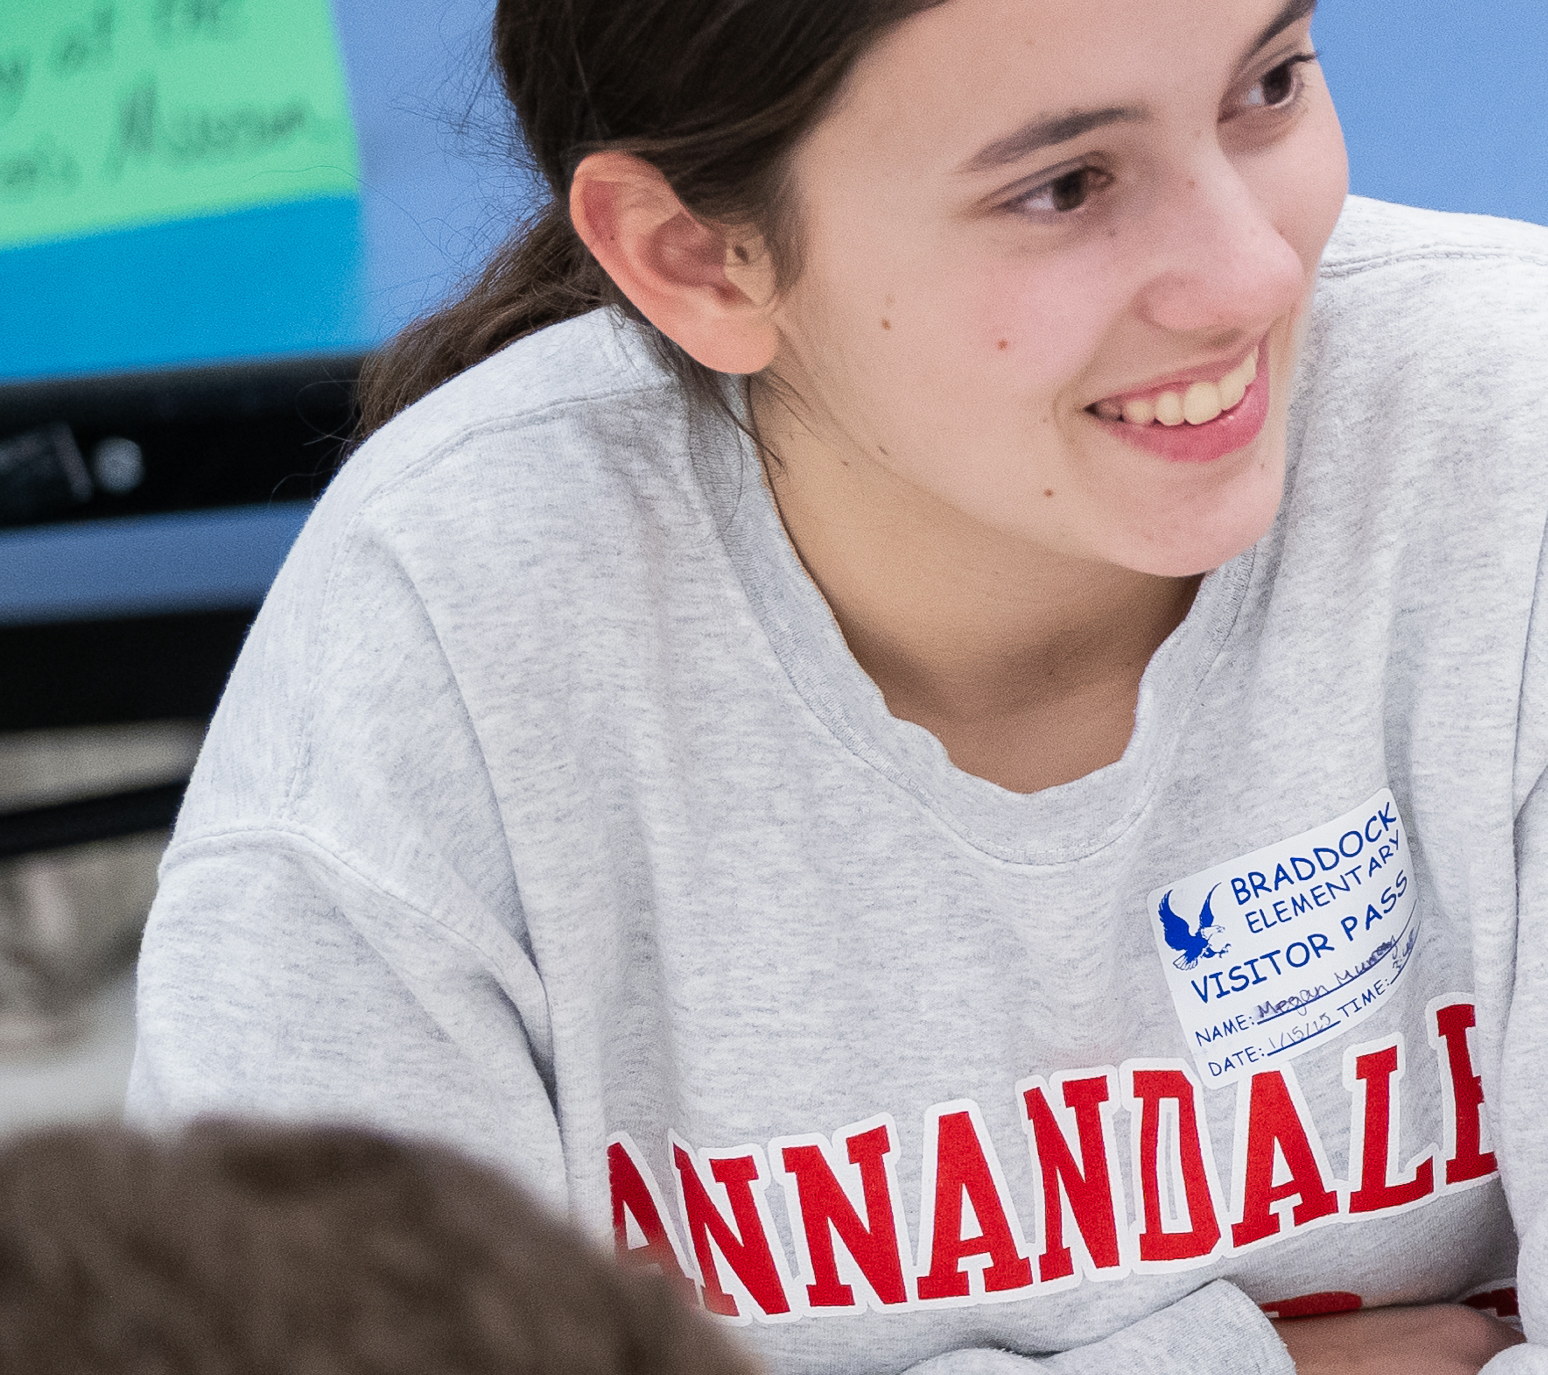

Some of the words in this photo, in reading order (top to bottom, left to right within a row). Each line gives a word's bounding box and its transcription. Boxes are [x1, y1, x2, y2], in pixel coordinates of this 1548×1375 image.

[1230, 802, 1397, 906] BRADDOCK
[1245, 829, 1399, 934] ELEMENTARY
[1191, 933, 1335, 1004] VISITOR
[1341, 870, 1408, 942] PASS
[1195, 1014, 1256, 1047] NAME:
[1337, 978, 1392, 1019] TIME:
[1208, 1046, 1266, 1077] DATE:
